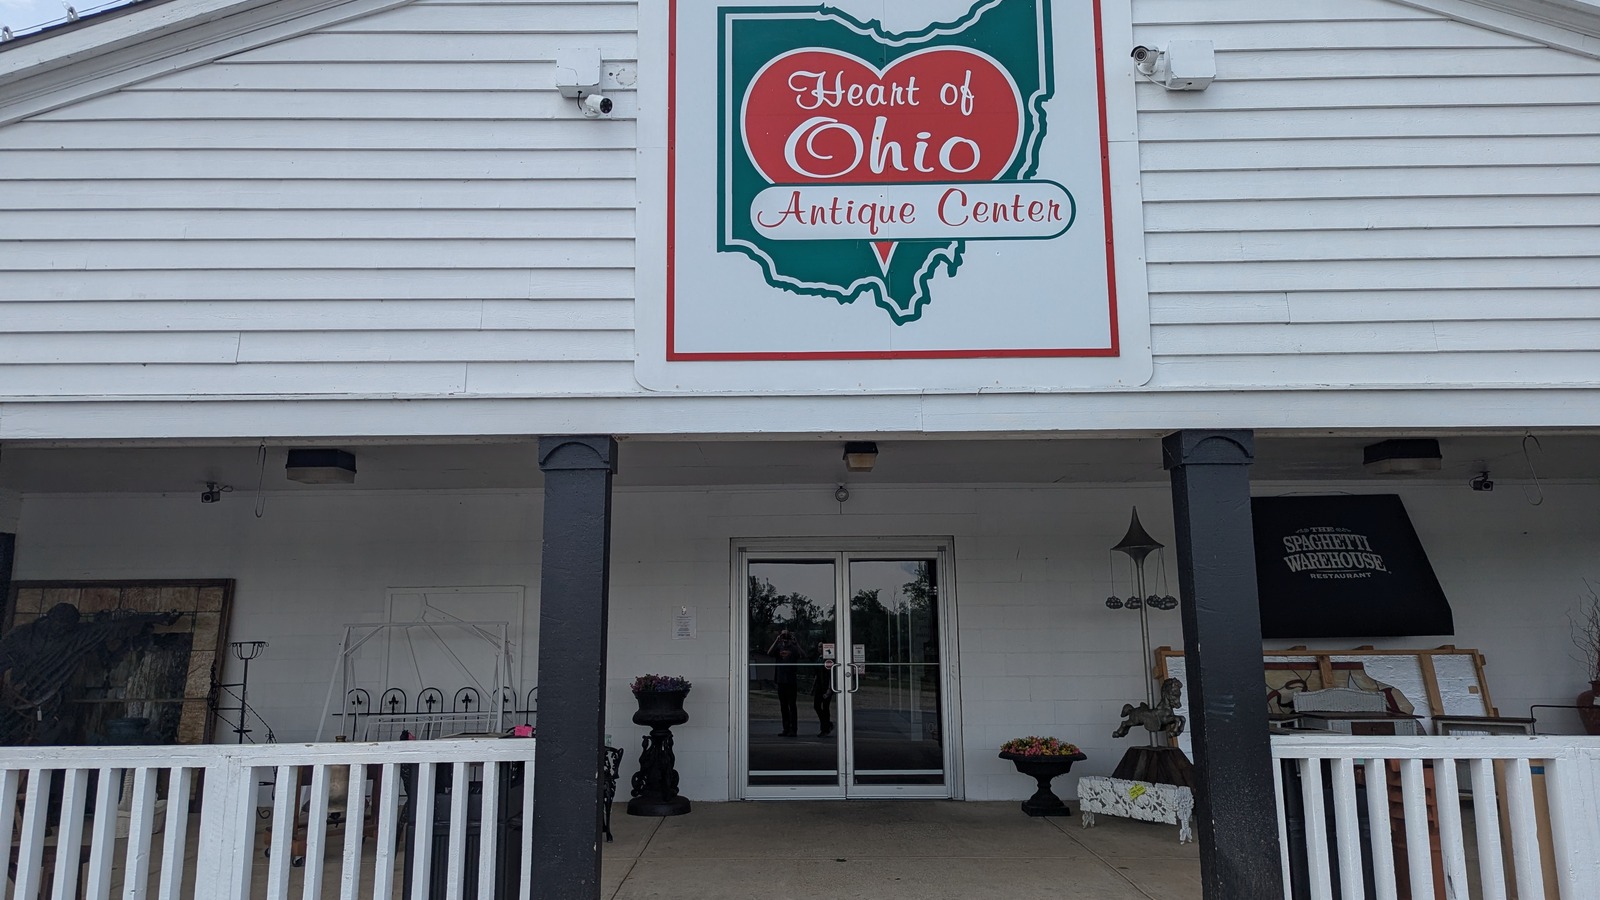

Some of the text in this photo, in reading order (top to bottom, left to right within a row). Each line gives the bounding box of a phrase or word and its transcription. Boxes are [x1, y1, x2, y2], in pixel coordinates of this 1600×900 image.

[787, 69, 975, 116] Heart of
[783, 115, 981, 178] Ohio
[757, 187, 1063, 236] Antique Center
[1282, 533, 1373, 553] SPAGHETTI
[1283, 552, 1387, 573] WAREHOUSE
